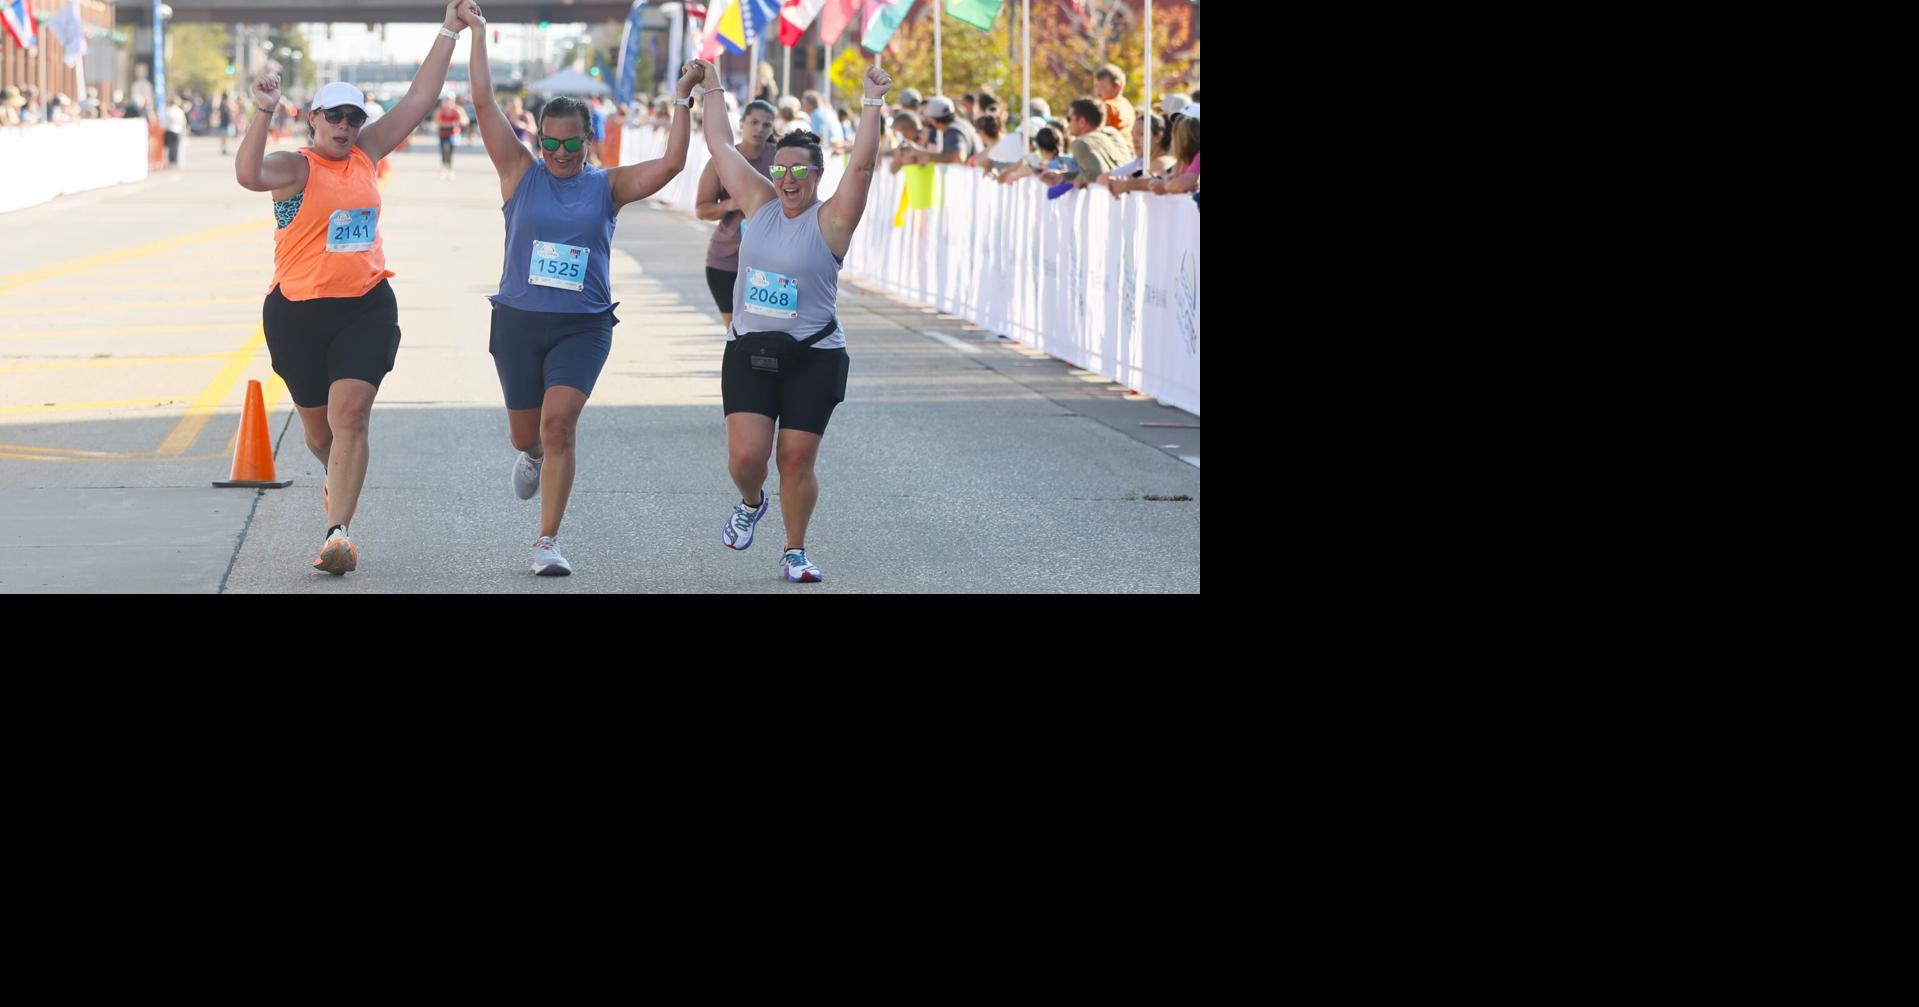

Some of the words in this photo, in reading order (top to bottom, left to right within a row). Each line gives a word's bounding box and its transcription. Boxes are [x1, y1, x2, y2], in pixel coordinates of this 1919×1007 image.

[335, 225, 368, 240] 2141
[538, 259, 580, 277] 1525
[750, 287, 789, 306] 2068
